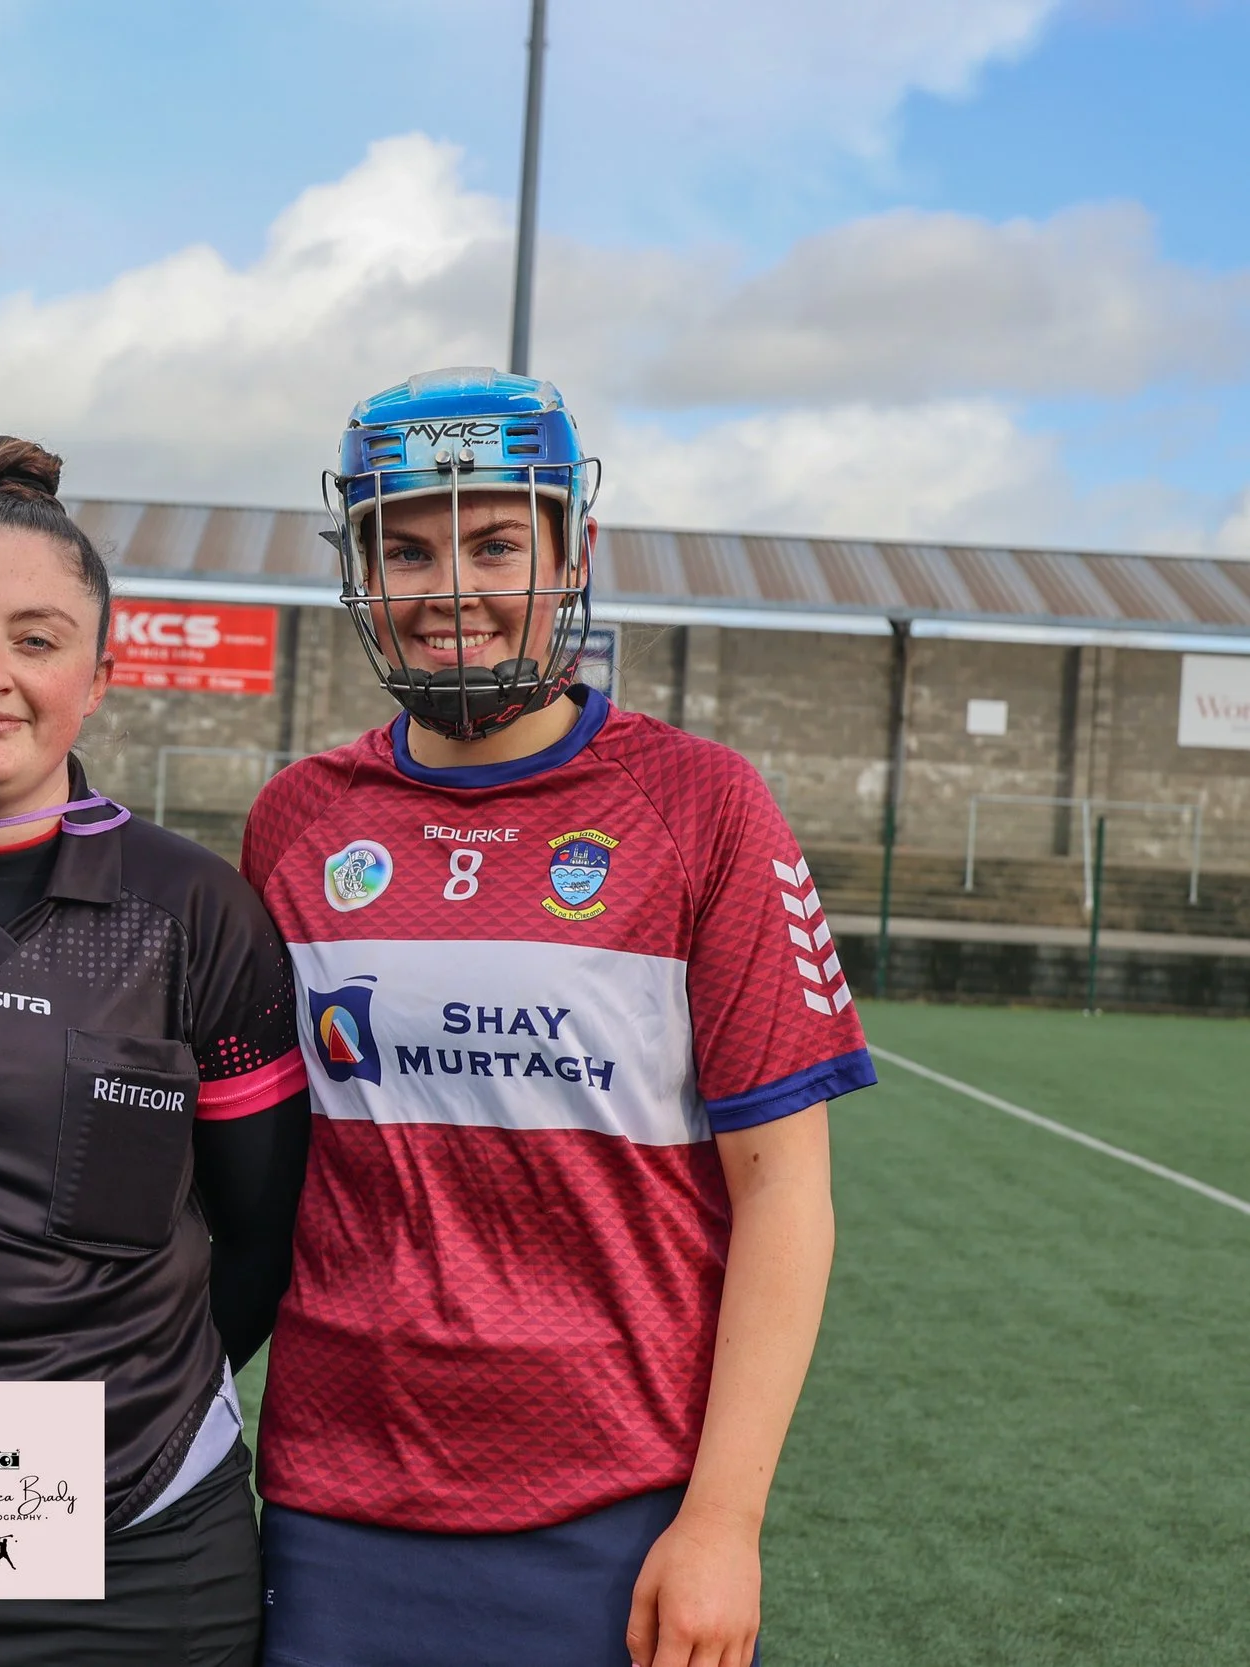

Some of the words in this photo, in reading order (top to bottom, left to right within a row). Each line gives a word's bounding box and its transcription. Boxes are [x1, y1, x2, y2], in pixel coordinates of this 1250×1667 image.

[114, 611, 221, 647] KCS
[424, 825, 519, 843] BOURKE
[443, 849, 483, 901] 8
[443, 1002, 570, 1040] SHAY
[395, 1045, 615, 1091] MURTAGH
[93, 1078, 185, 1112] RÉITEOIR
